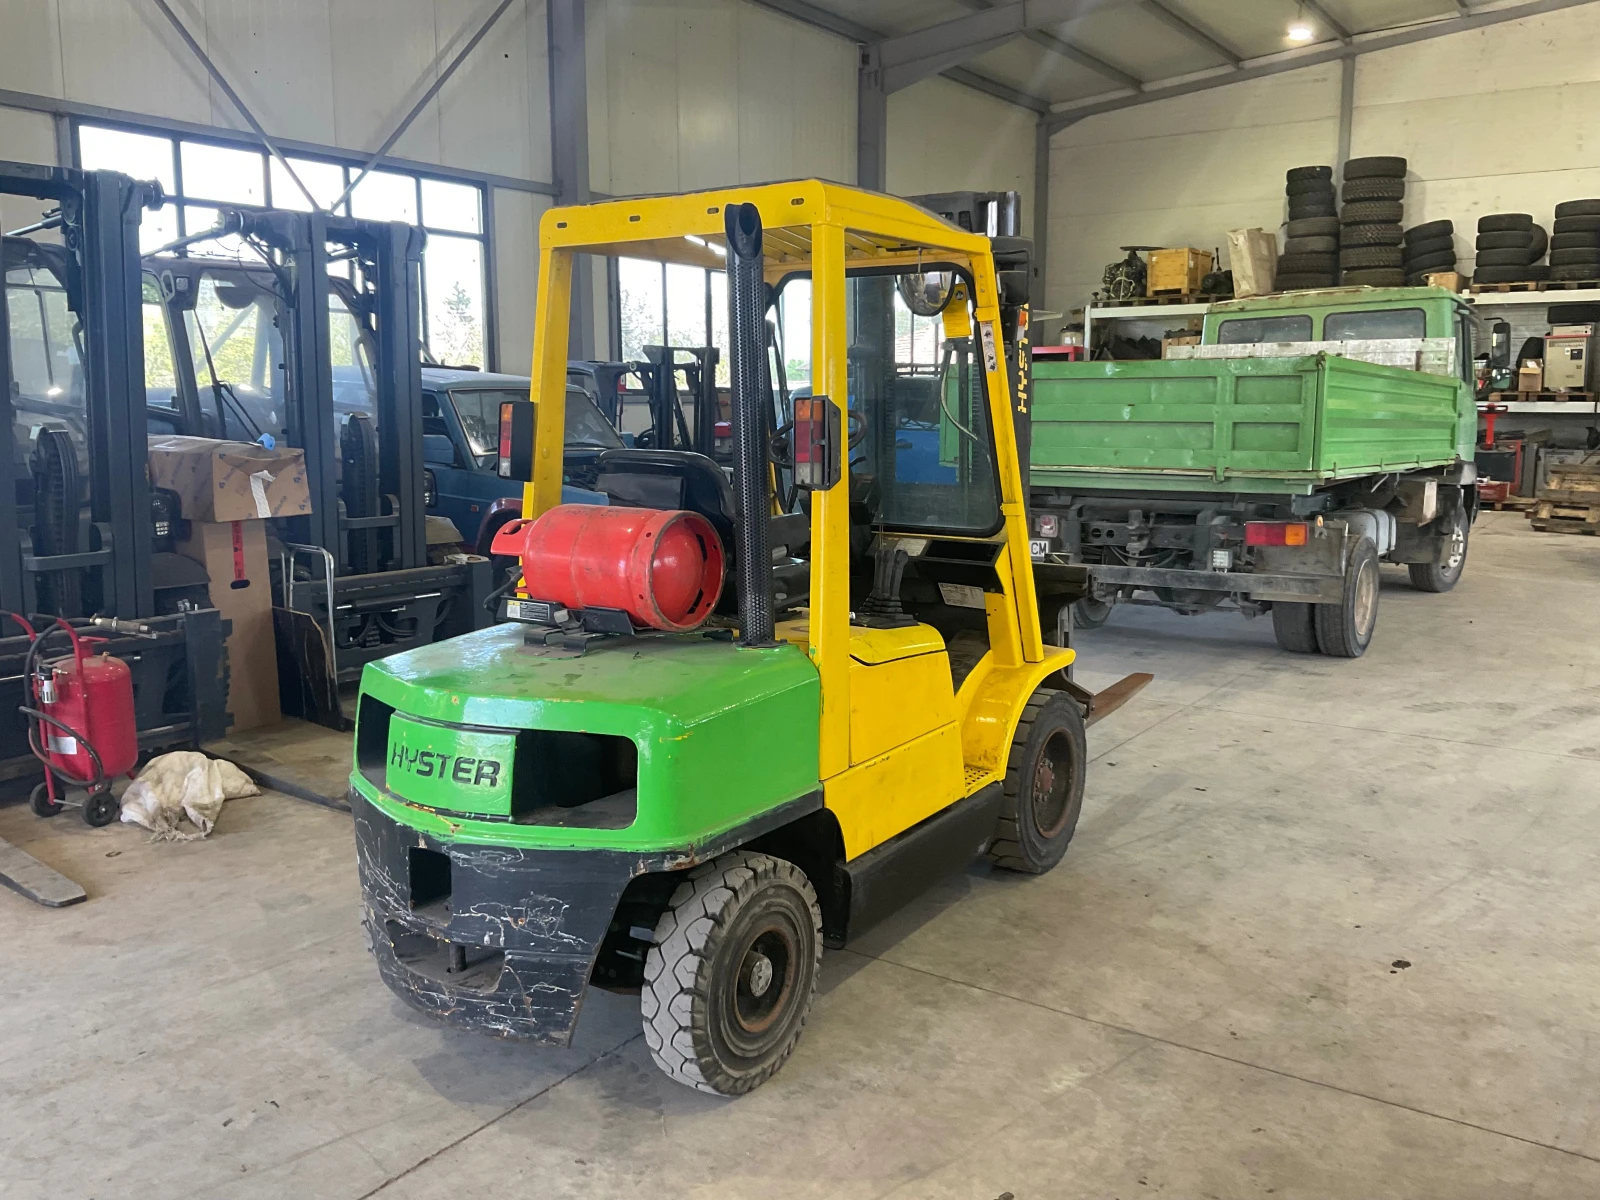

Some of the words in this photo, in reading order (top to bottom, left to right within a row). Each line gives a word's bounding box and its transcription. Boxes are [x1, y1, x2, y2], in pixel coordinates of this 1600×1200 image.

[1017, 303, 1029, 413] HYST
[1031, 542, 1047, 556] CM
[391, 741, 501, 788] HYSTER
